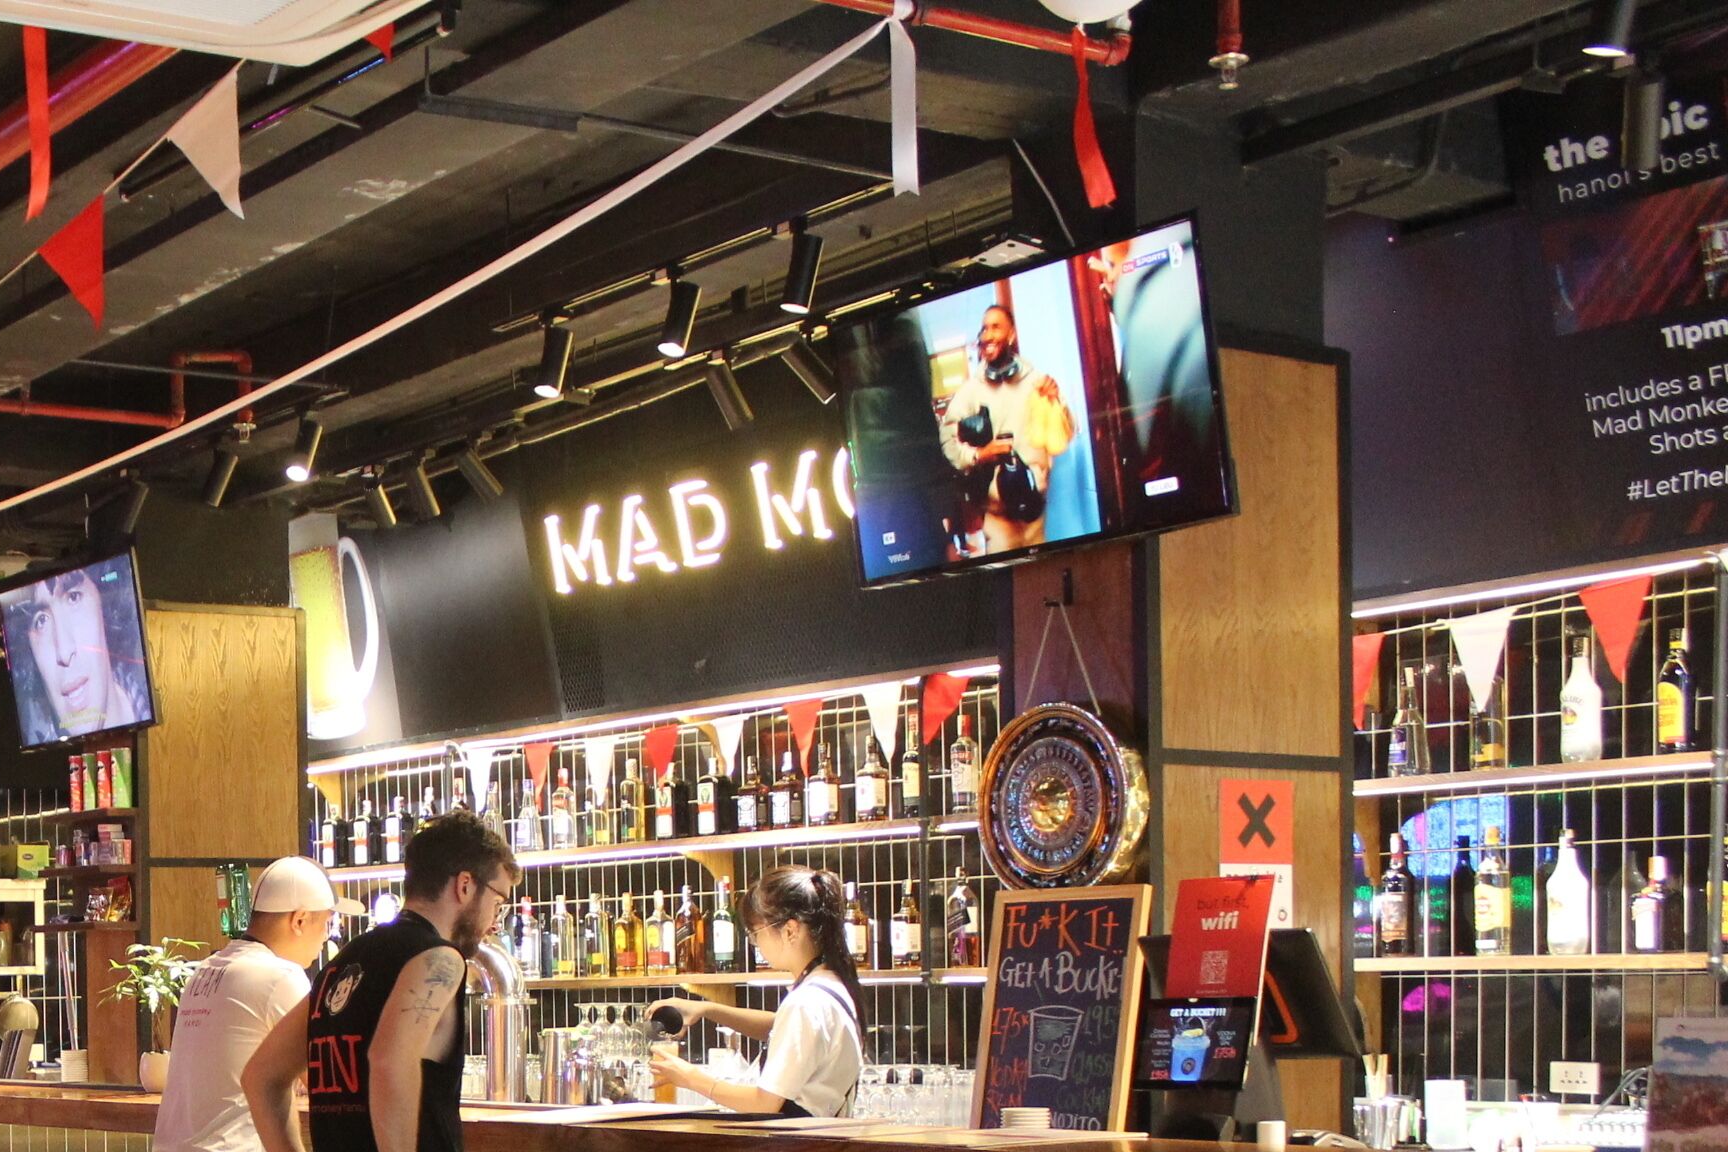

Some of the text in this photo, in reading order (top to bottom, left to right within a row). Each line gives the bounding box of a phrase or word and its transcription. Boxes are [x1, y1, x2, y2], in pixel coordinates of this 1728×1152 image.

[1542, 135, 1610, 172] the
[1660, 142, 1720, 174] best
[1584, 379, 1683, 412] includes
[1688, 375, 1702, 391] a
[1592, 411, 1642, 438] Mad
[1649, 428, 1717, 454] Shots
[1627, 465, 1728, 501] #LetThe
[543, 479, 726, 594] MAD
[1201, 911, 1240, 931] wifi
